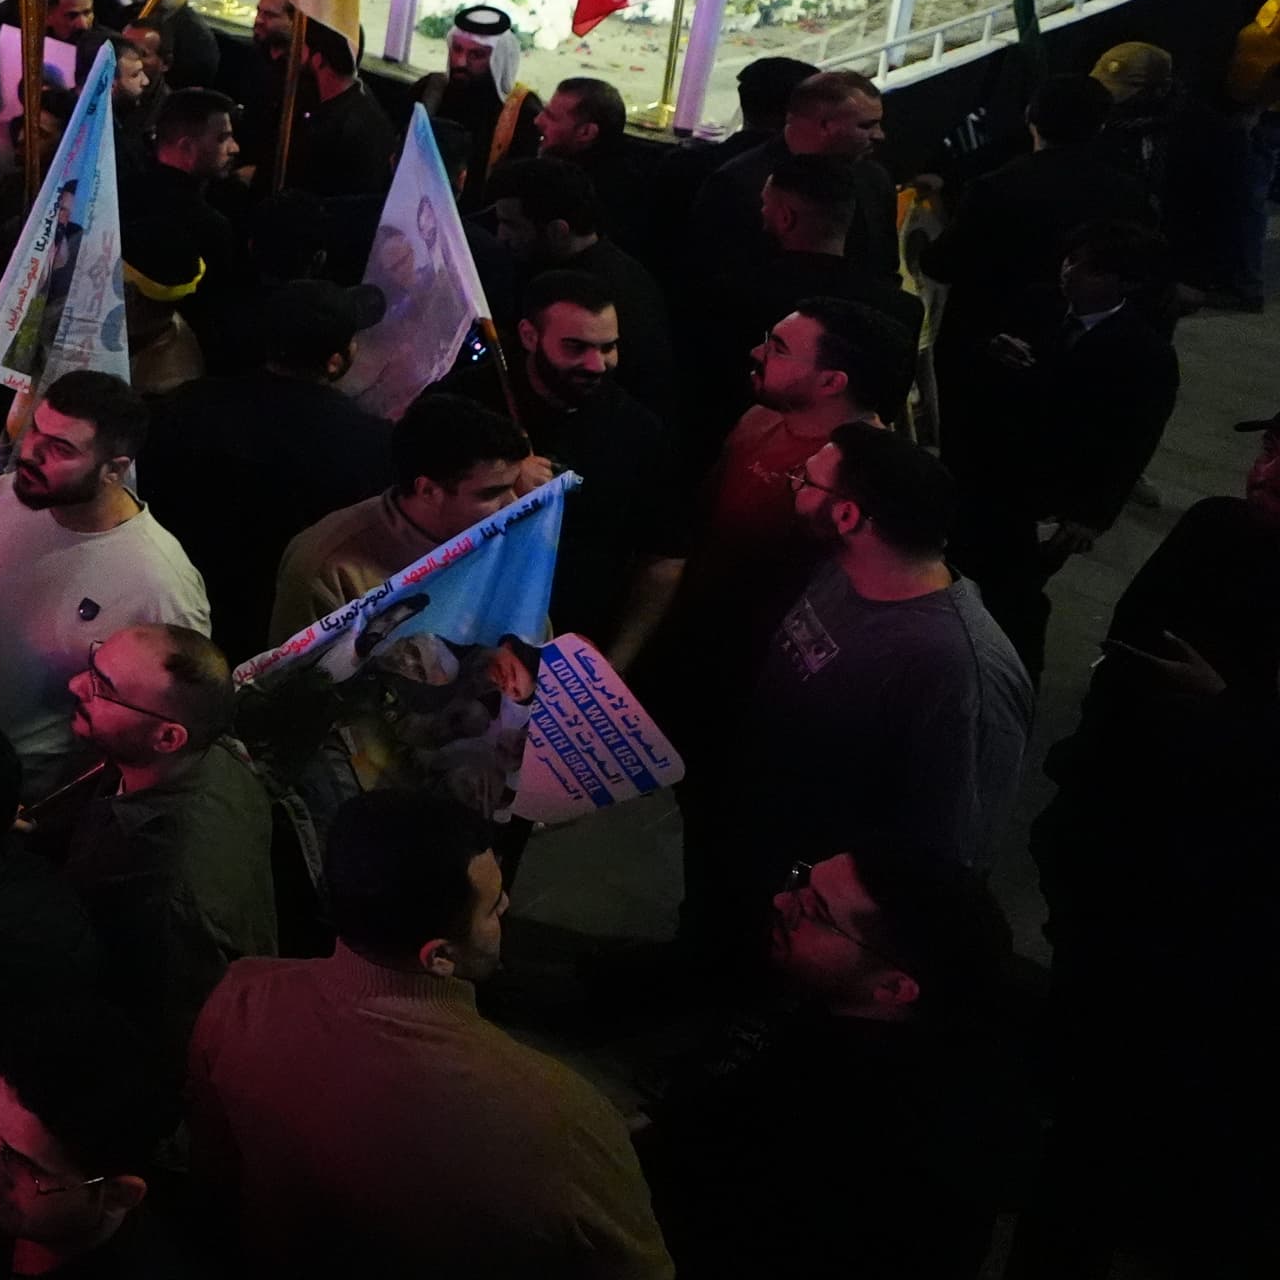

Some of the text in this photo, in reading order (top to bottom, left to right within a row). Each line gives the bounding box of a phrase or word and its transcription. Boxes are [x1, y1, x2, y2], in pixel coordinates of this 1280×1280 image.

[537, 714, 604, 796] WITH ISRAEL
[550, 658, 643, 778] DOWN WITH USA
